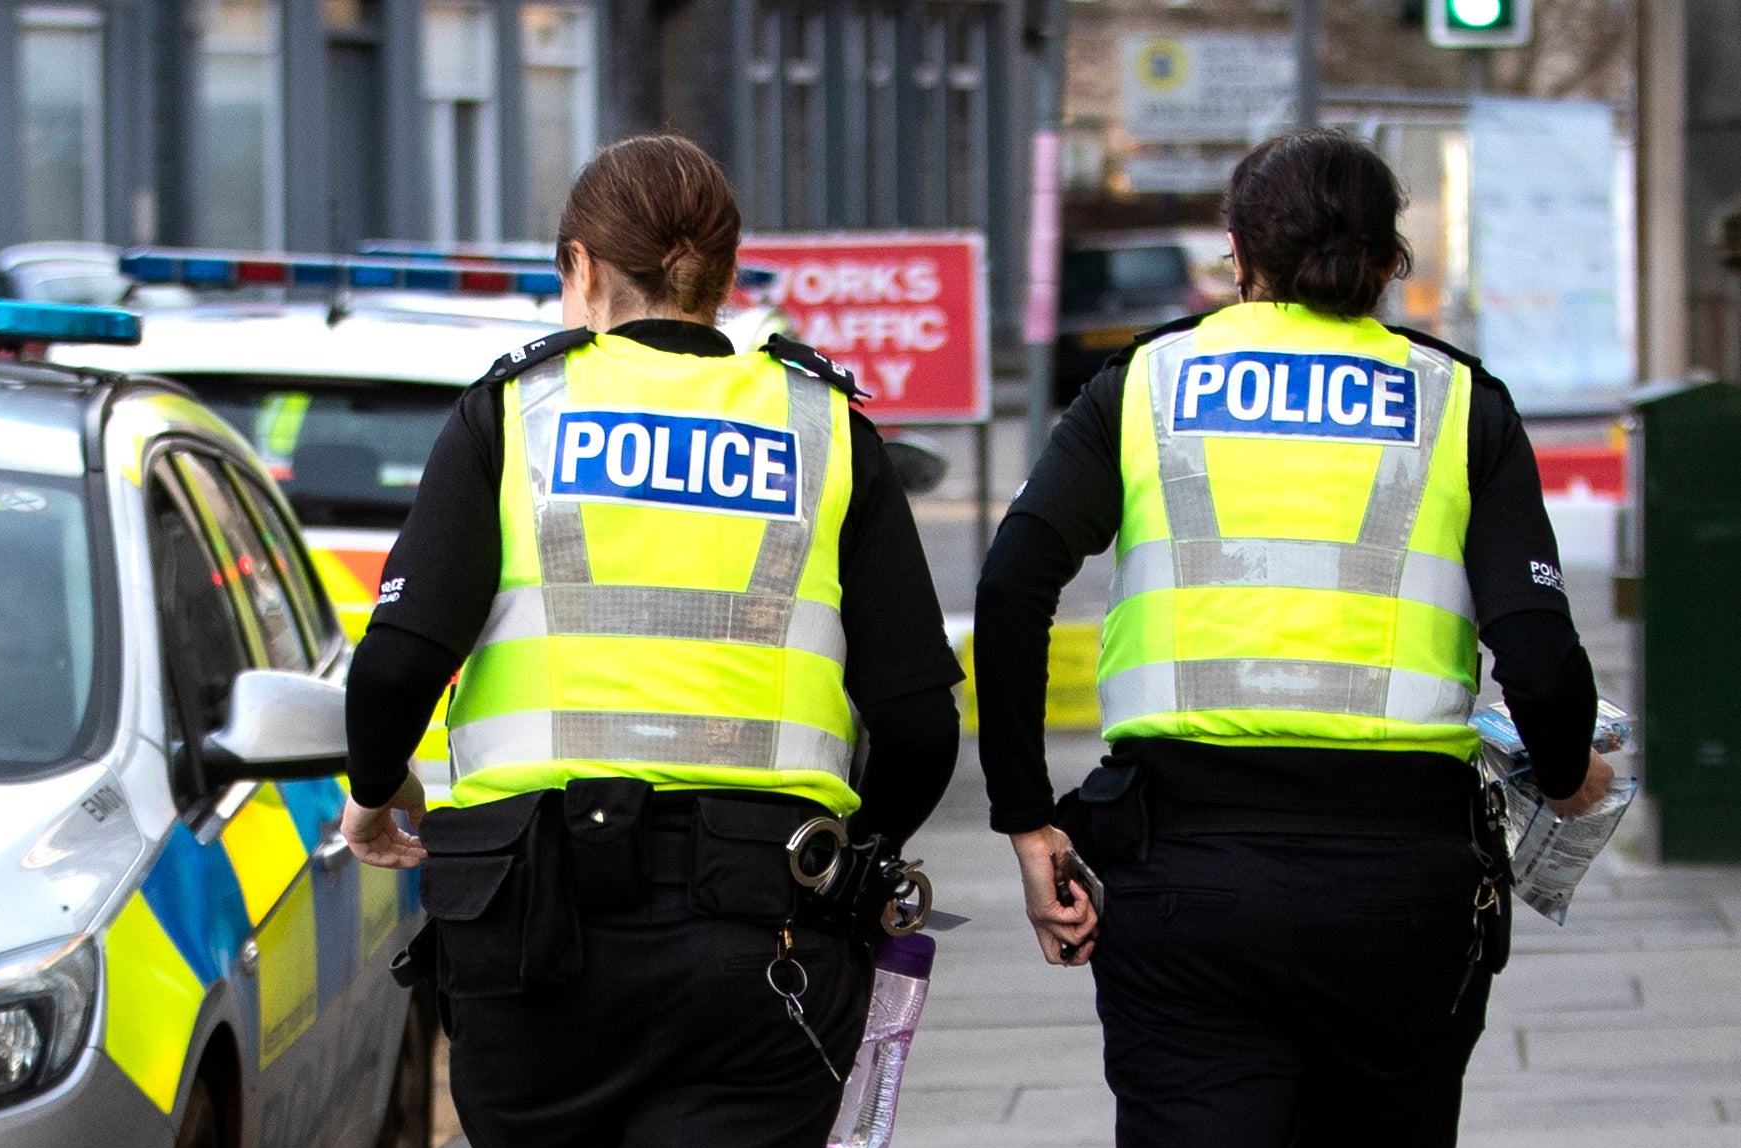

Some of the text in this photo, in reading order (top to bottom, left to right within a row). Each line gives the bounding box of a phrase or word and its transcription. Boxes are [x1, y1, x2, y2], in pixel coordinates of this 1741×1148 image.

[792, 308, 948, 352] AFFIC
[1183, 360, 1406, 428] POLICE
[561, 421, 787, 502] POLICE
